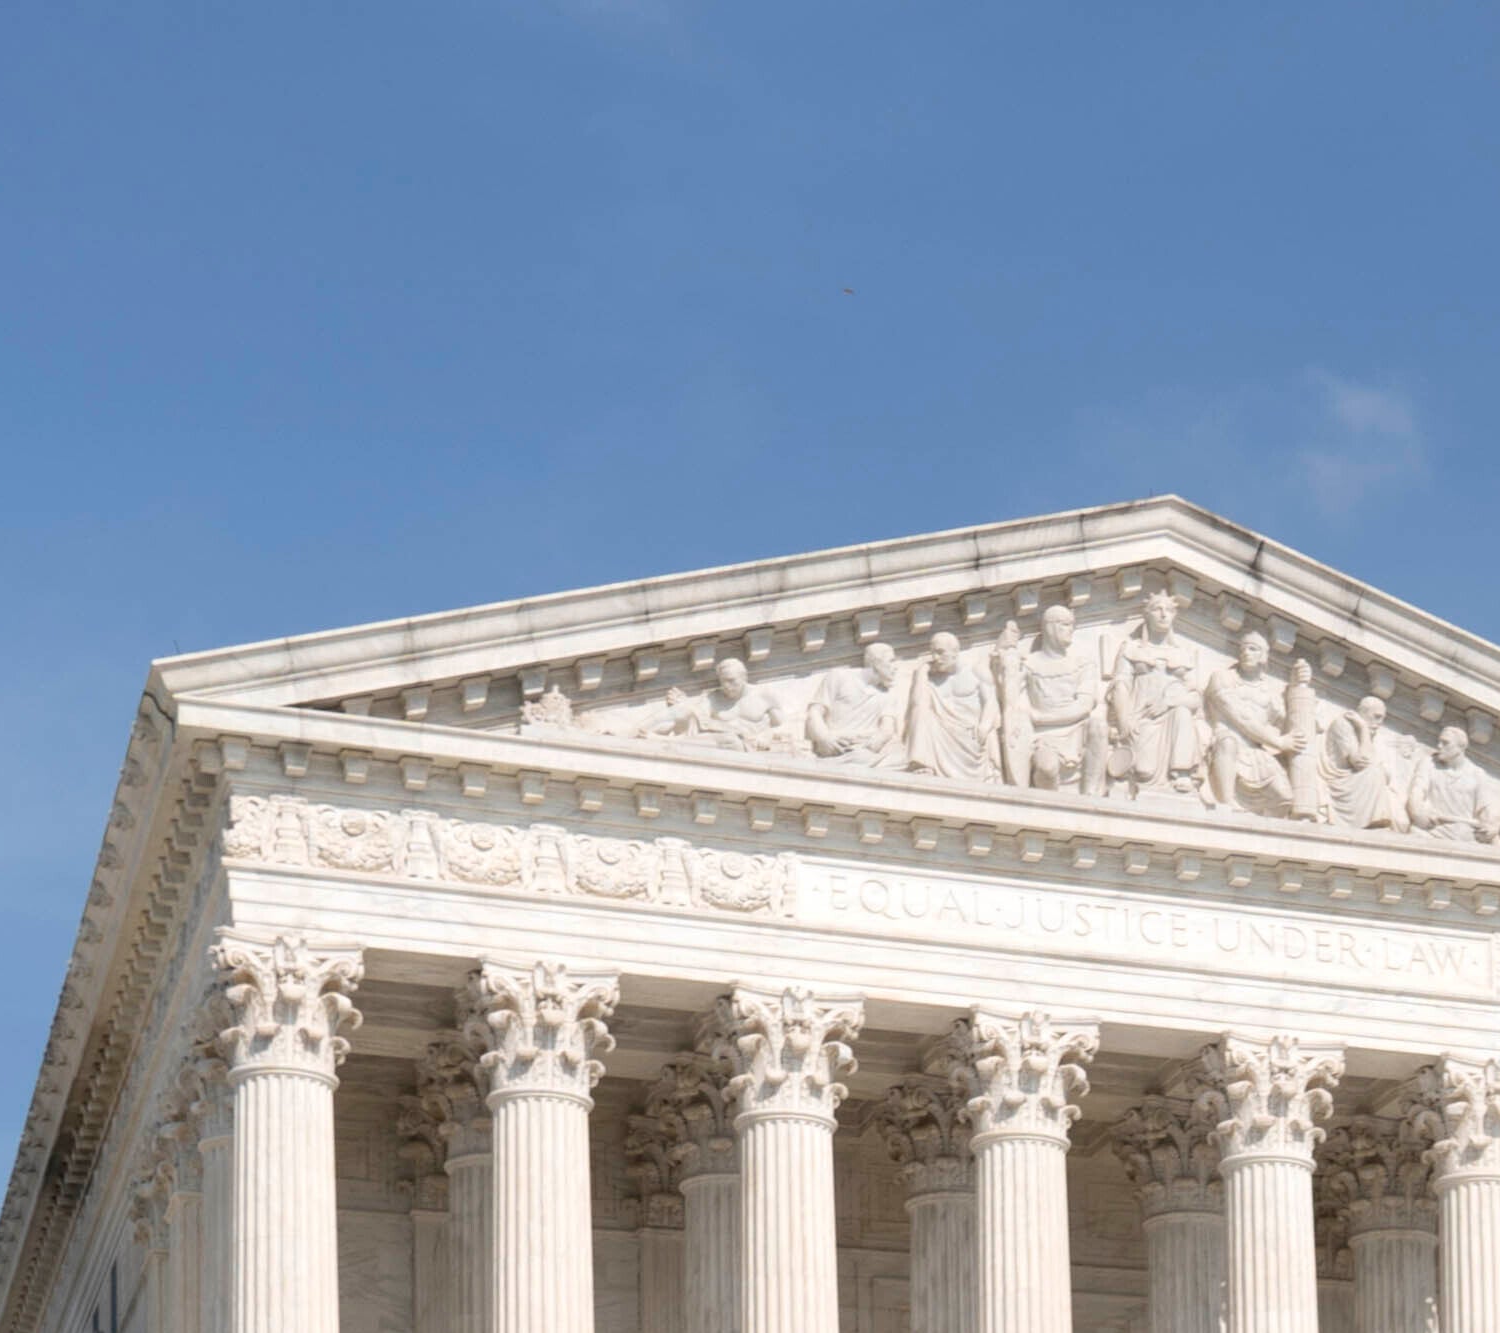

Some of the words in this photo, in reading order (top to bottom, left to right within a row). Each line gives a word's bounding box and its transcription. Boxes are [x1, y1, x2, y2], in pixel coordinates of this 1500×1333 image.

[830, 876, 992, 925] EQUAL
[1006, 896, 1187, 947] JUSTICE
[1215, 918, 1366, 967] UNDER
[1383, 938, 1466, 975] LAW
